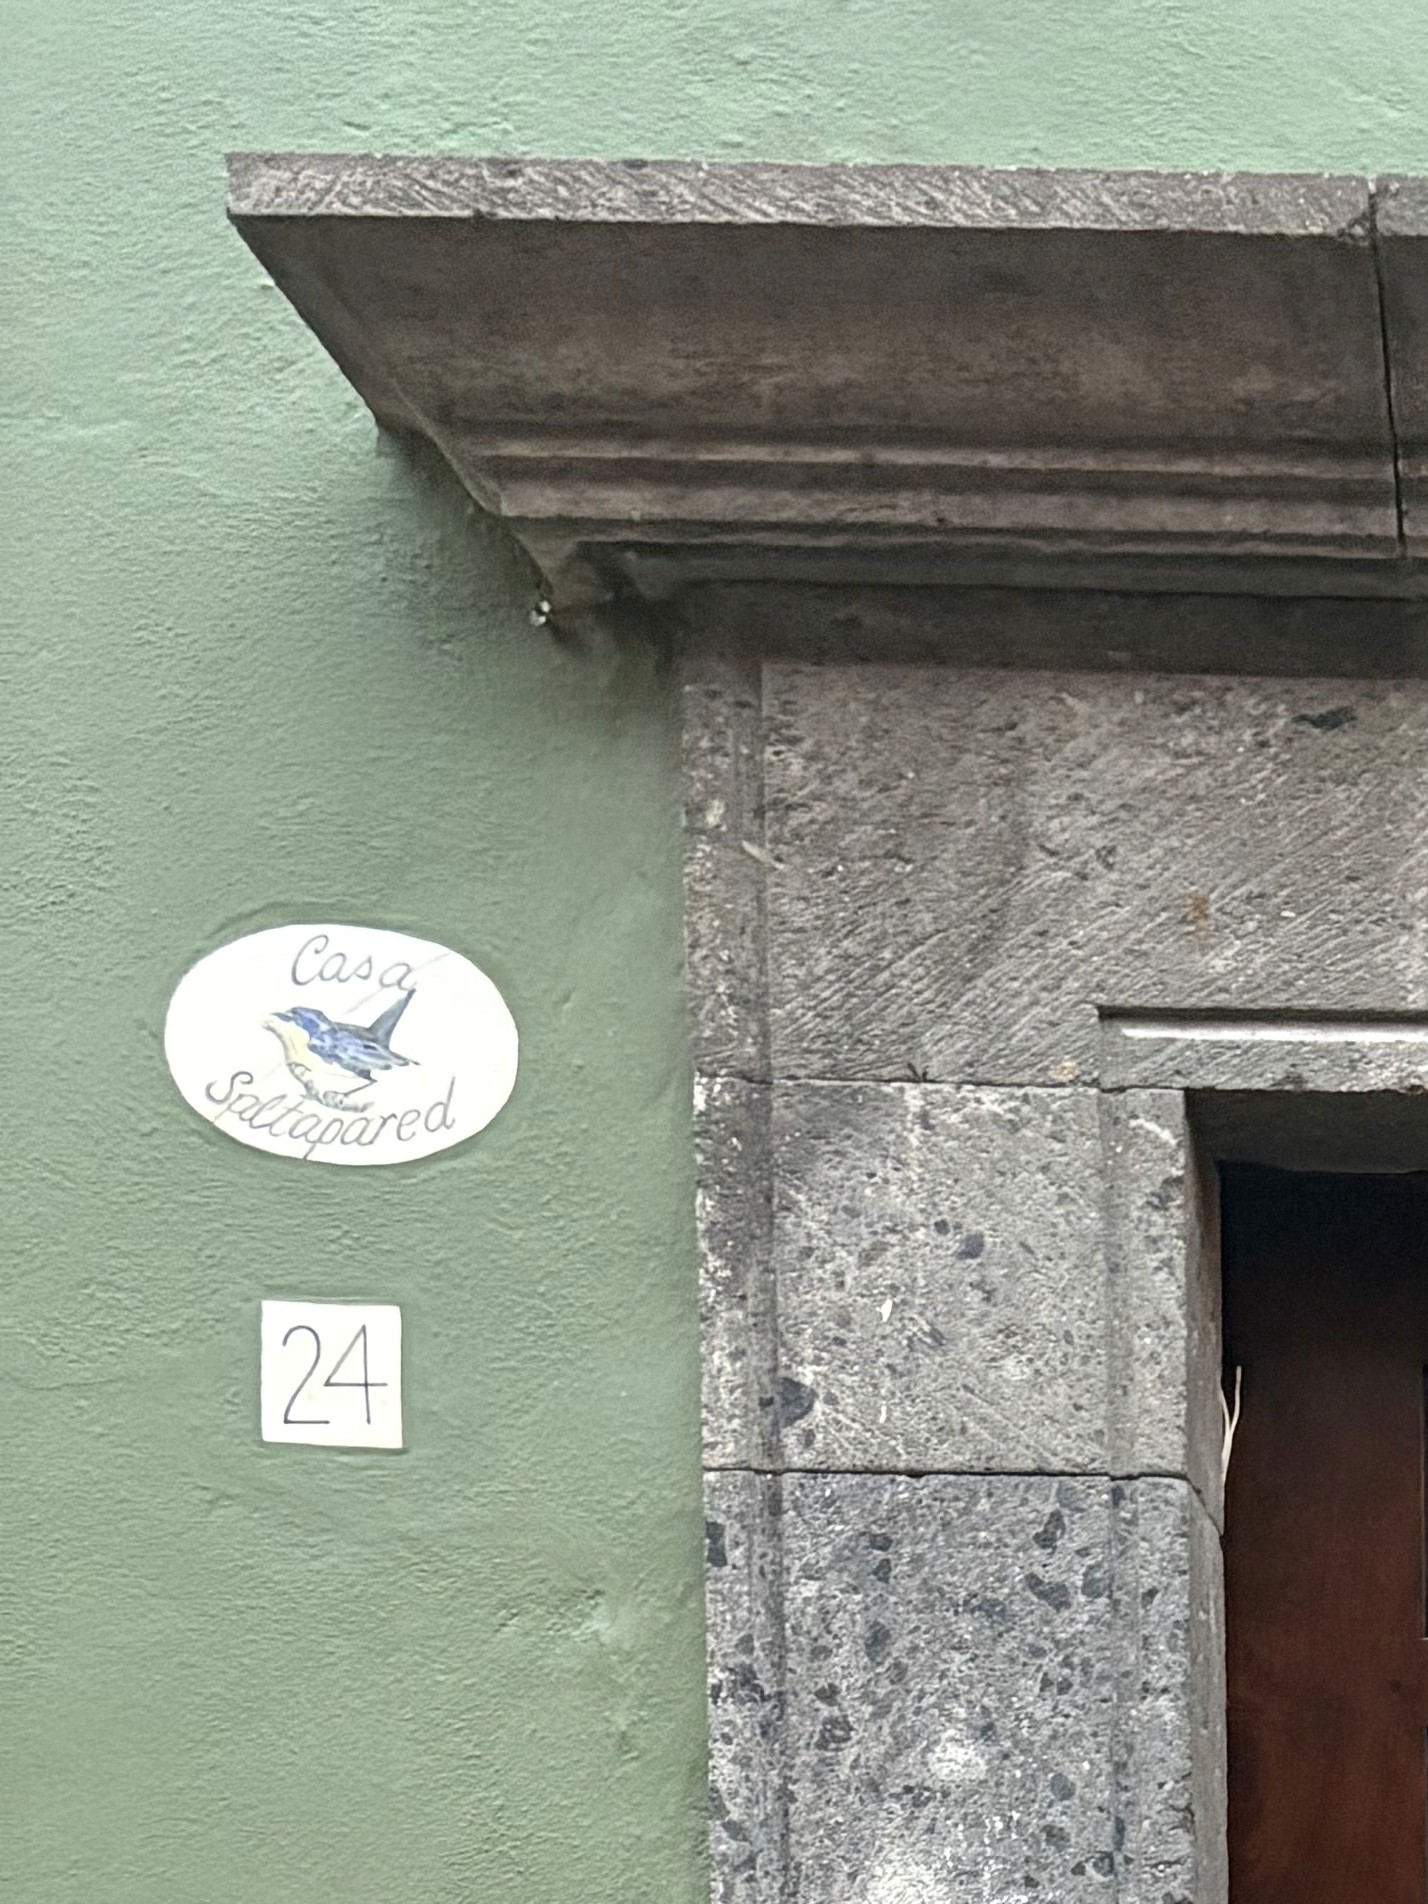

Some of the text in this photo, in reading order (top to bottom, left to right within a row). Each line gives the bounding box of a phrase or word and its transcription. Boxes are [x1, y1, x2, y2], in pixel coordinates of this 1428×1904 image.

[291, 934, 417, 991] Casa
[205, 1071, 456, 1160] Saltapared
[282, 1324, 388, 1426] 24
